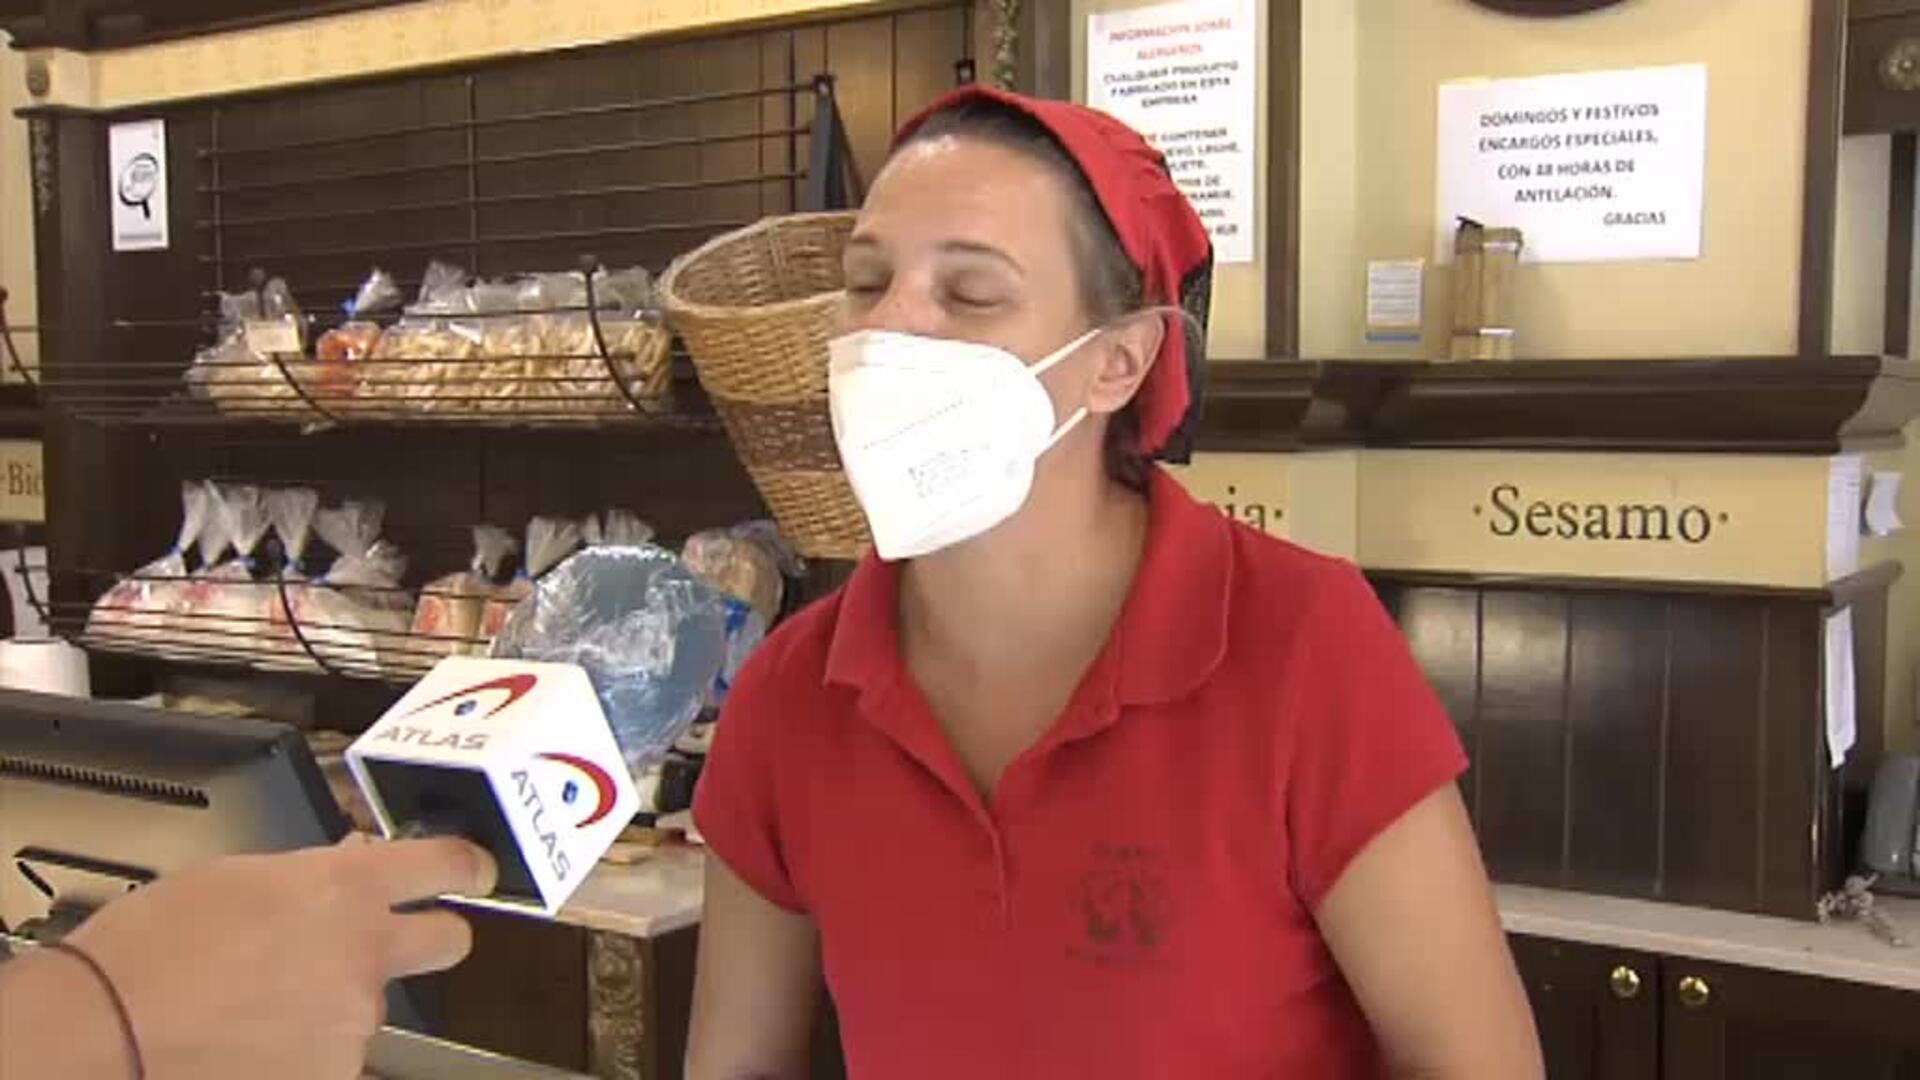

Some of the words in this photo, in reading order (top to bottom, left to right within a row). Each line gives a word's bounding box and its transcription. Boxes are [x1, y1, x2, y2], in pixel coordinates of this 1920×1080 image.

[1480, 108, 1567, 128] DOMINGOS
[1572, 106, 1581, 120] Y
[1585, 103, 1659, 120] FESTIVOS
[1479, 133, 1561, 152] ENCARGOS
[1498, 163, 1531, 180] CON
[1557, 160, 1611, 176] HORAS
[1615, 159, 1635, 173] DE
[1603, 210, 1667, 226] GRACIAS
[372, 726, 491, 750] ATLAS
[511, 769, 572, 882] ATLAS
